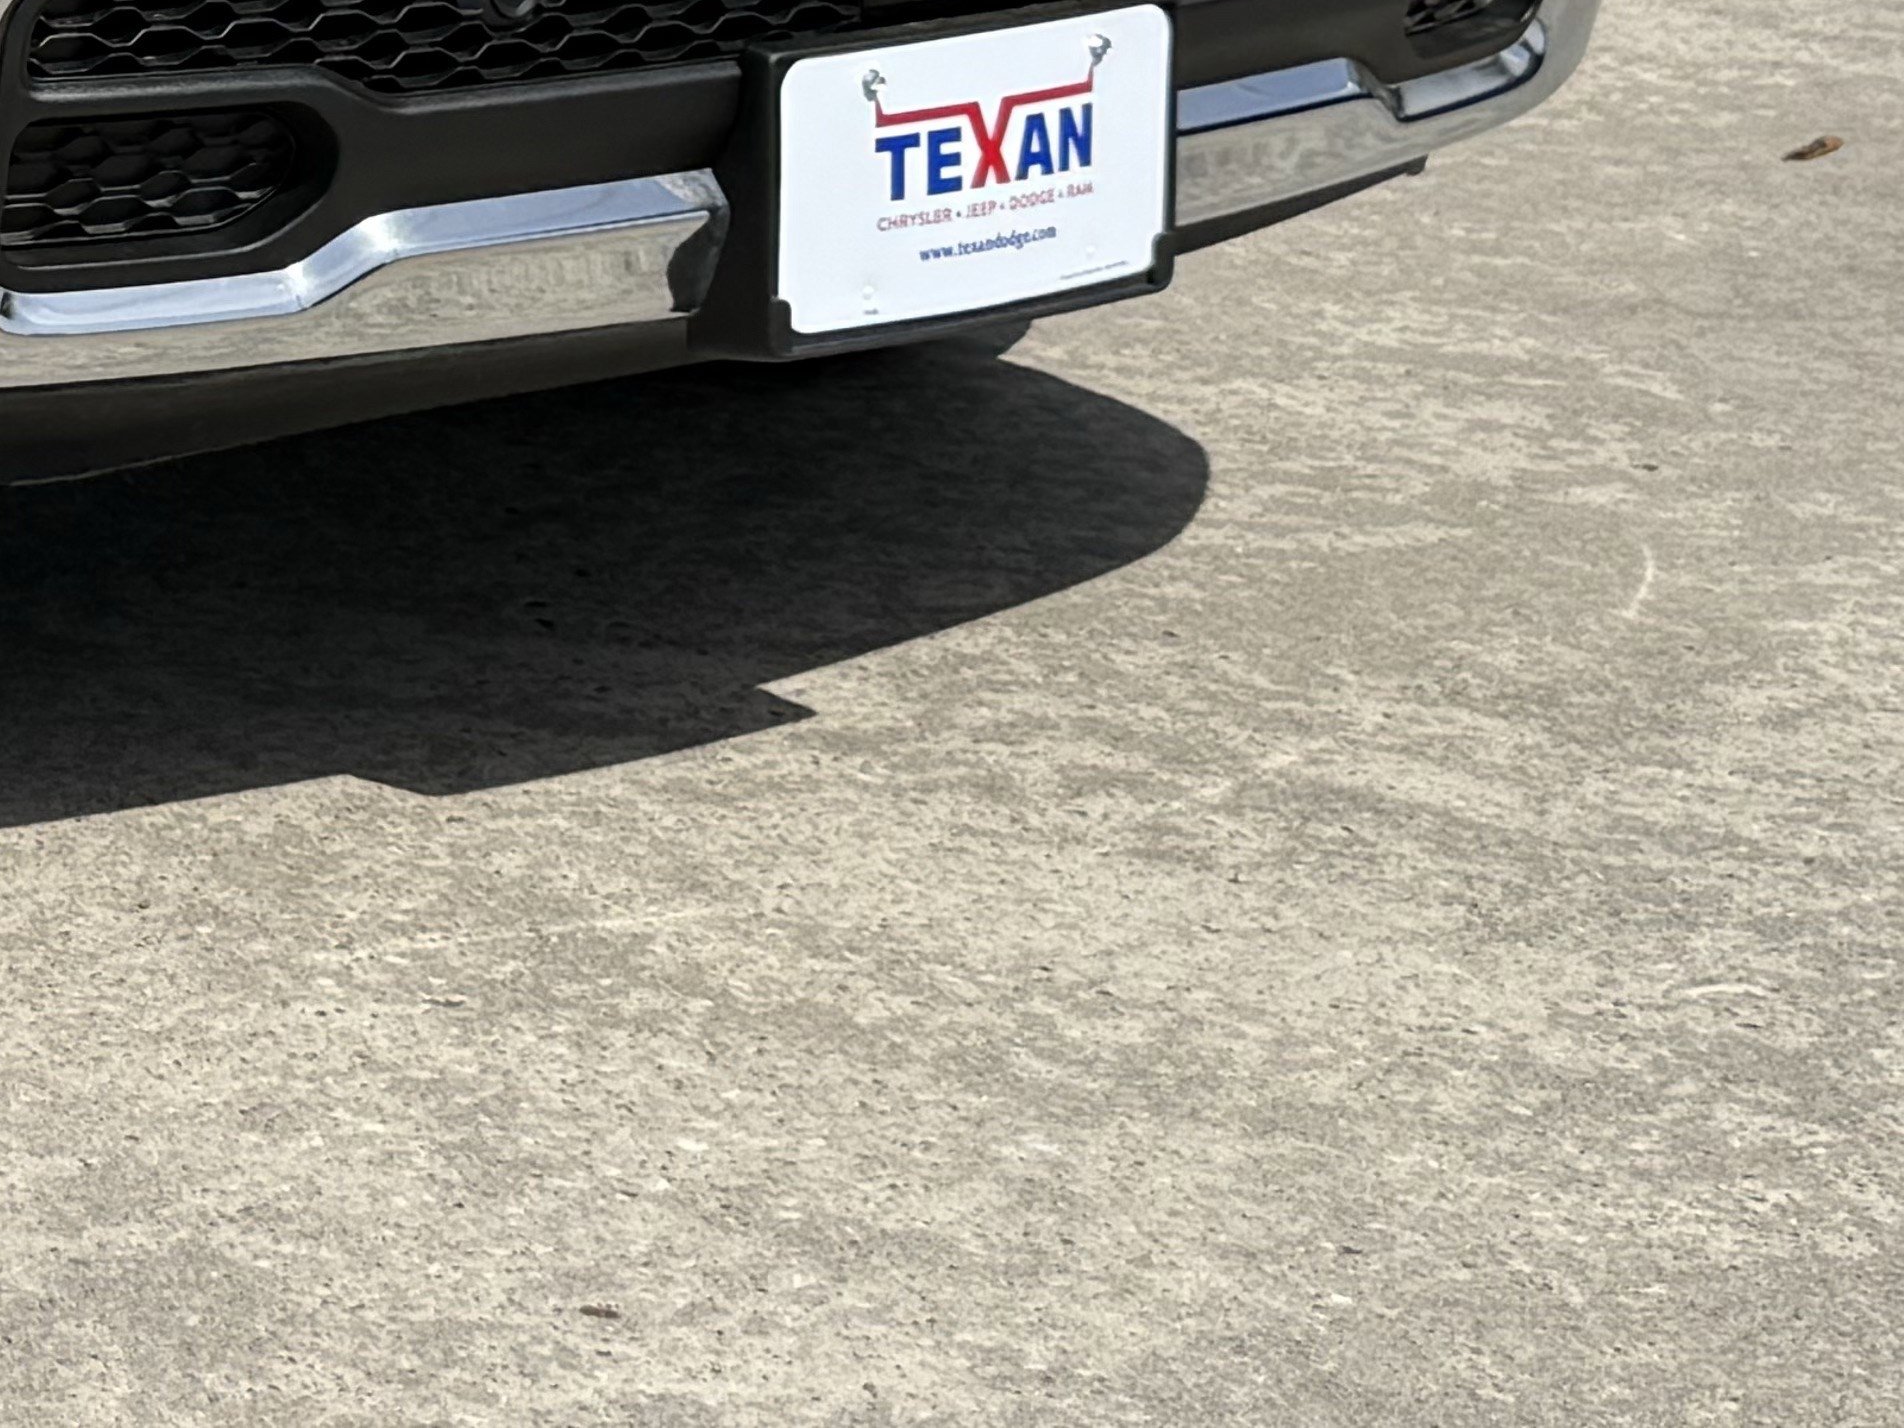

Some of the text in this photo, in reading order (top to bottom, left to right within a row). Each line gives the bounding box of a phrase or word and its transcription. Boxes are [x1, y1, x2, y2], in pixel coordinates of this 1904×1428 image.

[874, 89, 1094, 202] TEXAN
[875, 181, 1096, 233] CHRYSLER JEEP DODGE RAM
